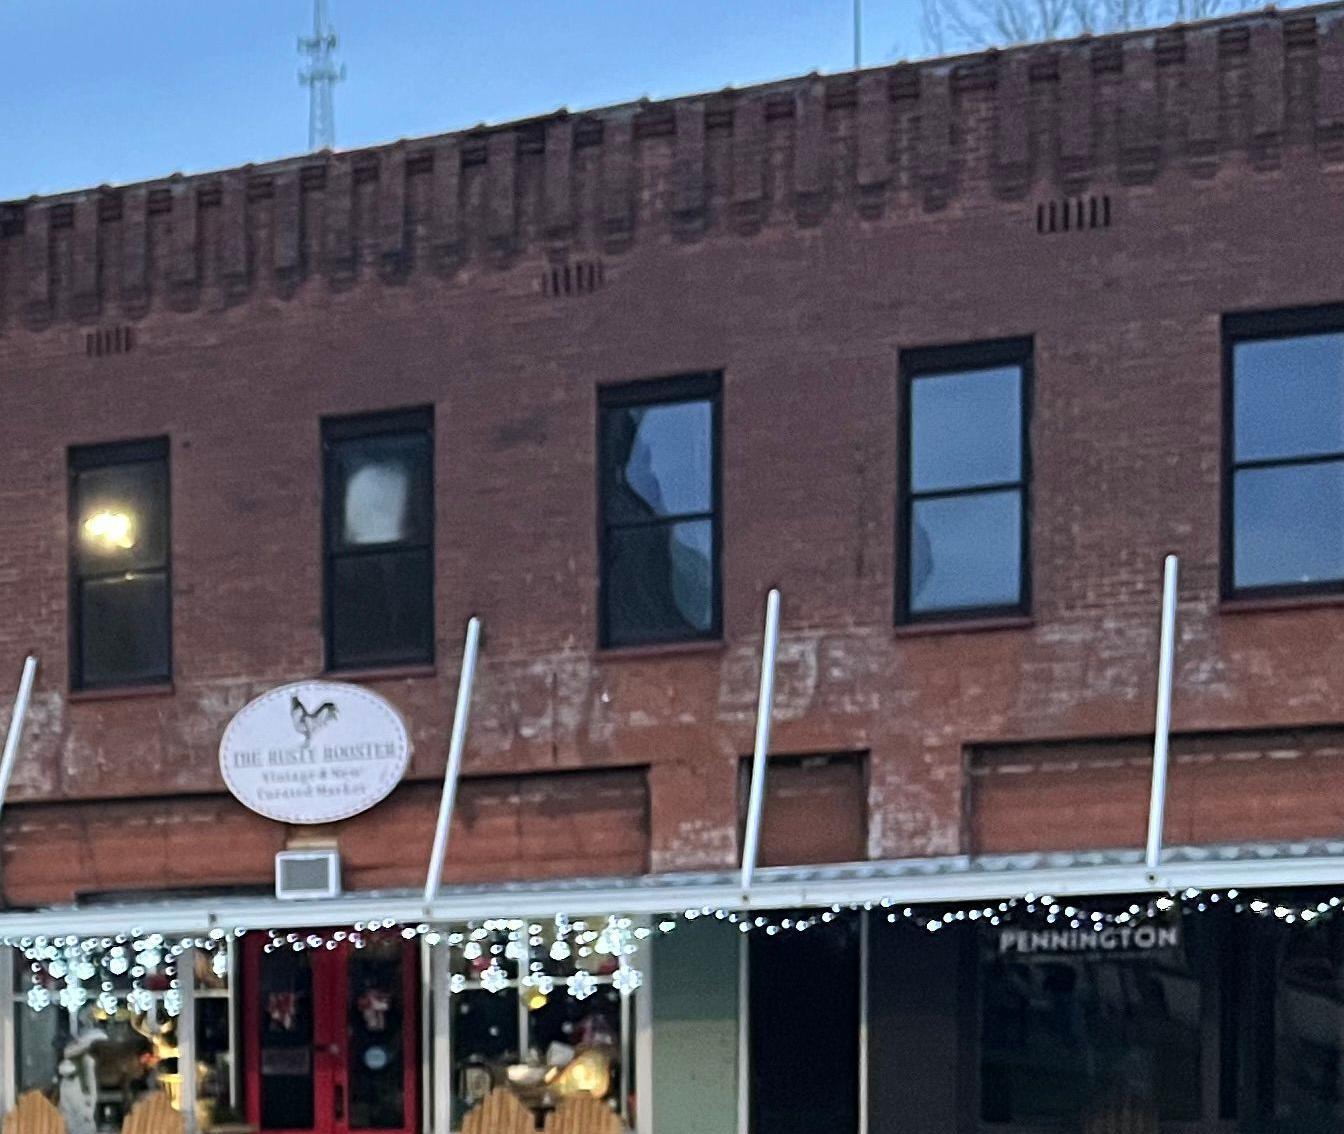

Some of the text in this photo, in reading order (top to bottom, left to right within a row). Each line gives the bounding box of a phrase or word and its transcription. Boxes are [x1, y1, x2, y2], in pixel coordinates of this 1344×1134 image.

[233, 742, 395, 767] THE RUSTY ROOSTER
[998, 926, 1178, 953] PENNINGTON
